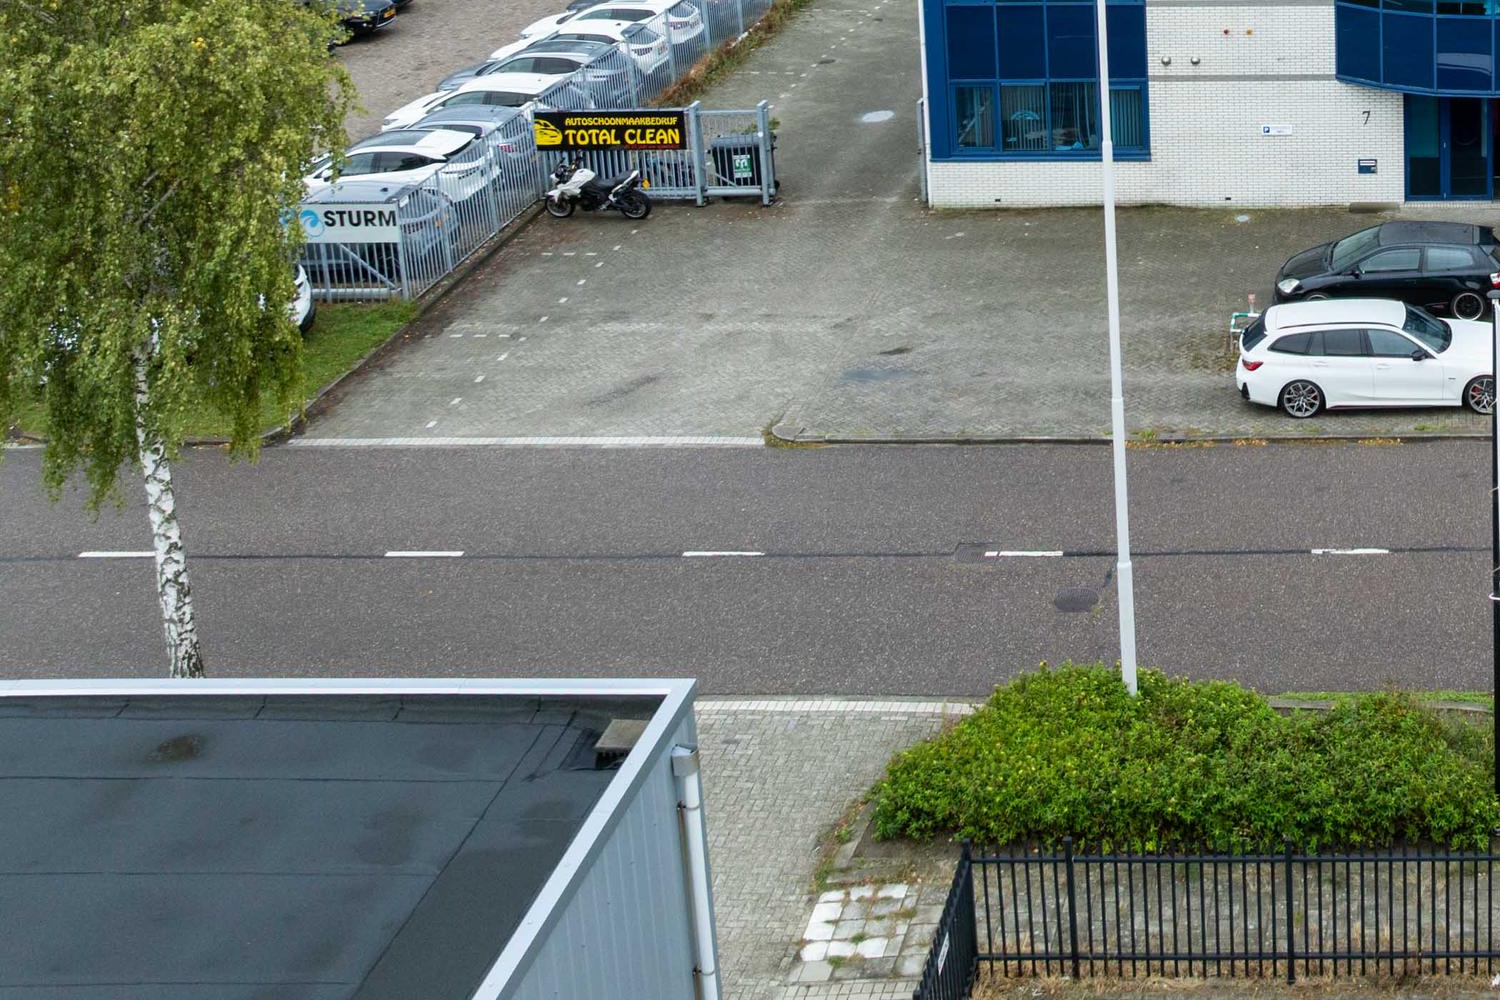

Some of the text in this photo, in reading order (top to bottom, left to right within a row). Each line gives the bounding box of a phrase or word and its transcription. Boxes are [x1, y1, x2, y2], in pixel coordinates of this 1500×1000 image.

[565, 116, 678, 126] AUTOSCHOONMAAKBEDRIJF
[1362, 110, 1371, 125] 7
[565, 128, 680, 145] TOTAL CLEAN
[324, 210, 397, 227] STURM
